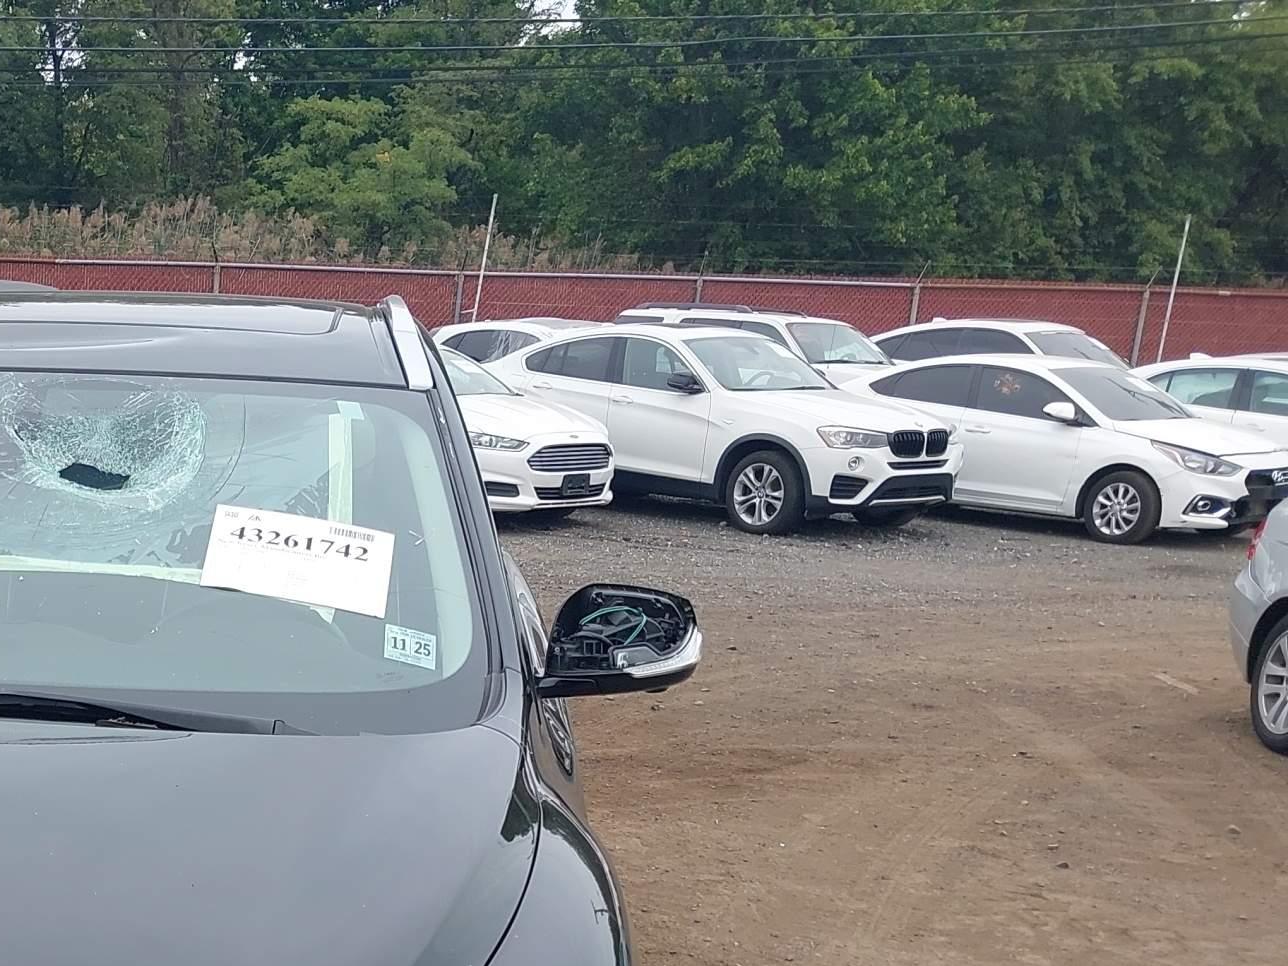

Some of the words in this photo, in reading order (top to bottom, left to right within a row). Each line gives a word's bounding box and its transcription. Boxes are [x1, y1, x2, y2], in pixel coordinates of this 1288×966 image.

[229, 526, 369, 562] 43261742
[391, 636, 408, 651] 11
[413, 641, 431, 657] 25
